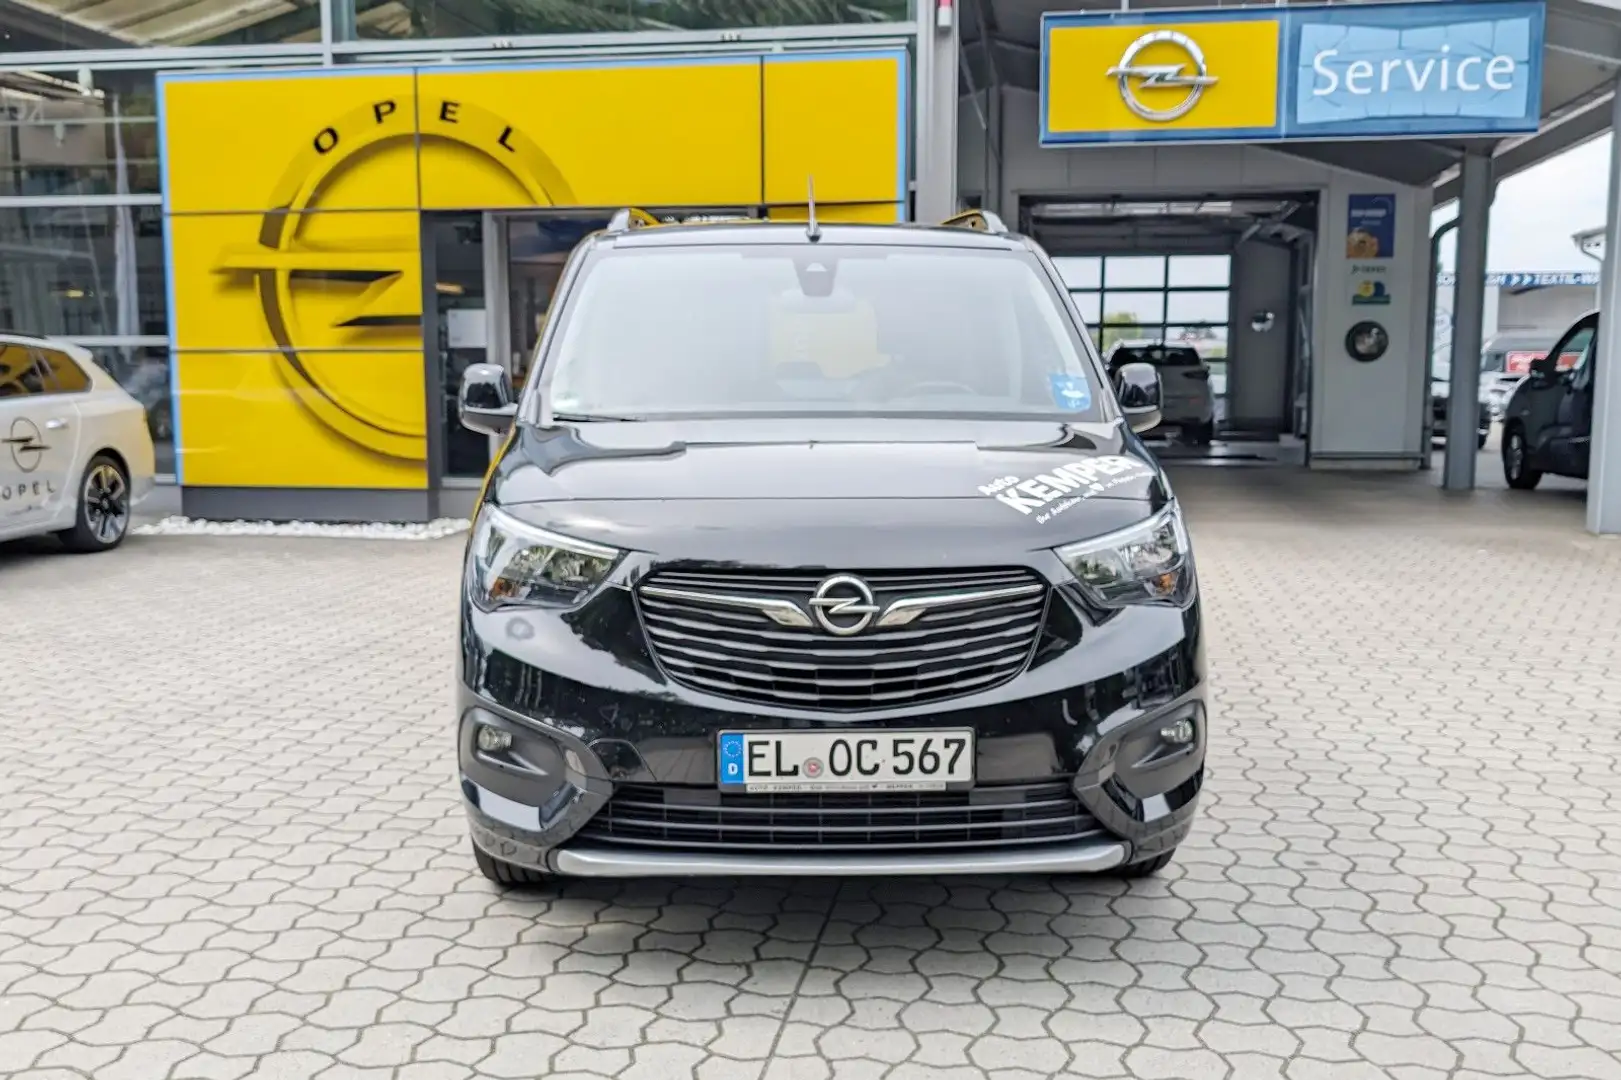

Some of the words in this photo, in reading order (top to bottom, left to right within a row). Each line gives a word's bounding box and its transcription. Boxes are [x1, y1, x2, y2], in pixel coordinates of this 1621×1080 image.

[1313, 44, 1515, 96] Service
[313, 100, 516, 155] OPEL
[2, 480, 56, 501] OPEL
[978, 475, 1020, 496] Auto
[995, 455, 1144, 515] KEMPER
[727, 763, 738, 775] D
[748, 740, 799, 777] EL
[829, 739, 881, 777] OC
[893, 738, 967, 776] 567
